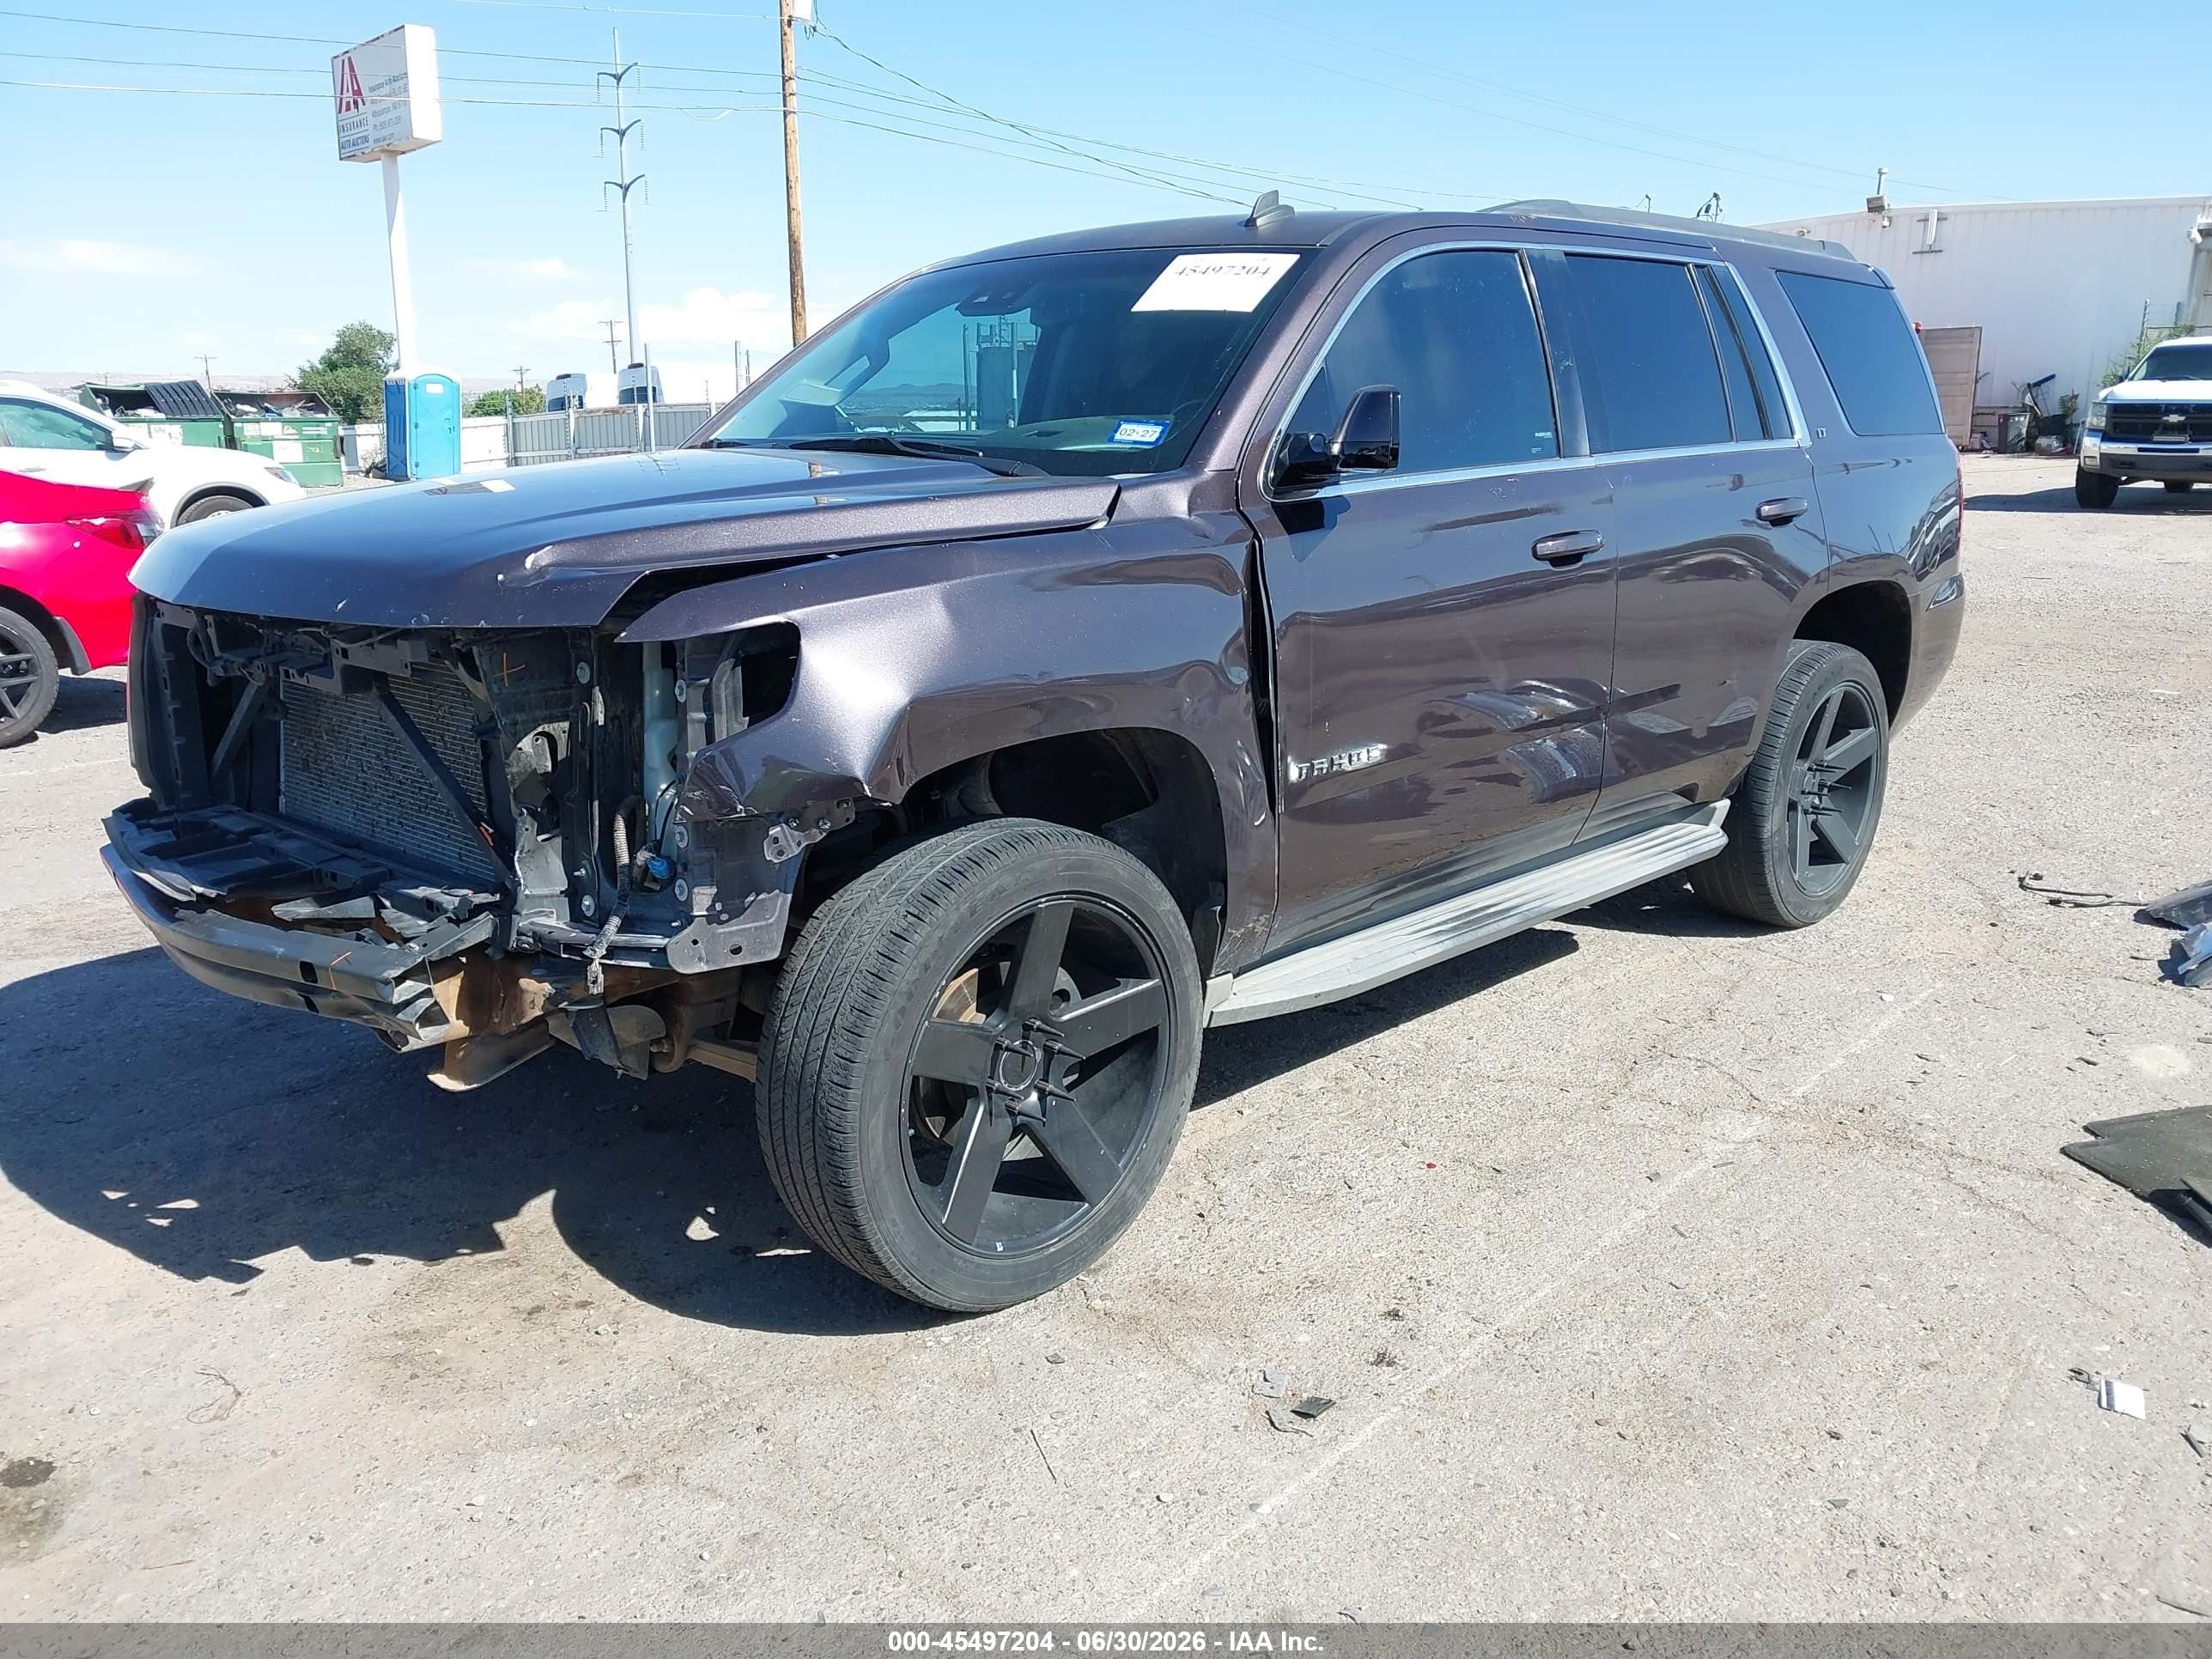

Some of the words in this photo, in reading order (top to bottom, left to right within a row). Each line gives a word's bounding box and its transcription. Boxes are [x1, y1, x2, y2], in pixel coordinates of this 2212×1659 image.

[338, 116, 369, 134] INSURANCE
[340, 137, 351, 150] AUTO
[350, 133, 370, 148] AUCTIONS
[1119, 428, 1135, 437] 02
[1139, 429, 1158, 438] 27
